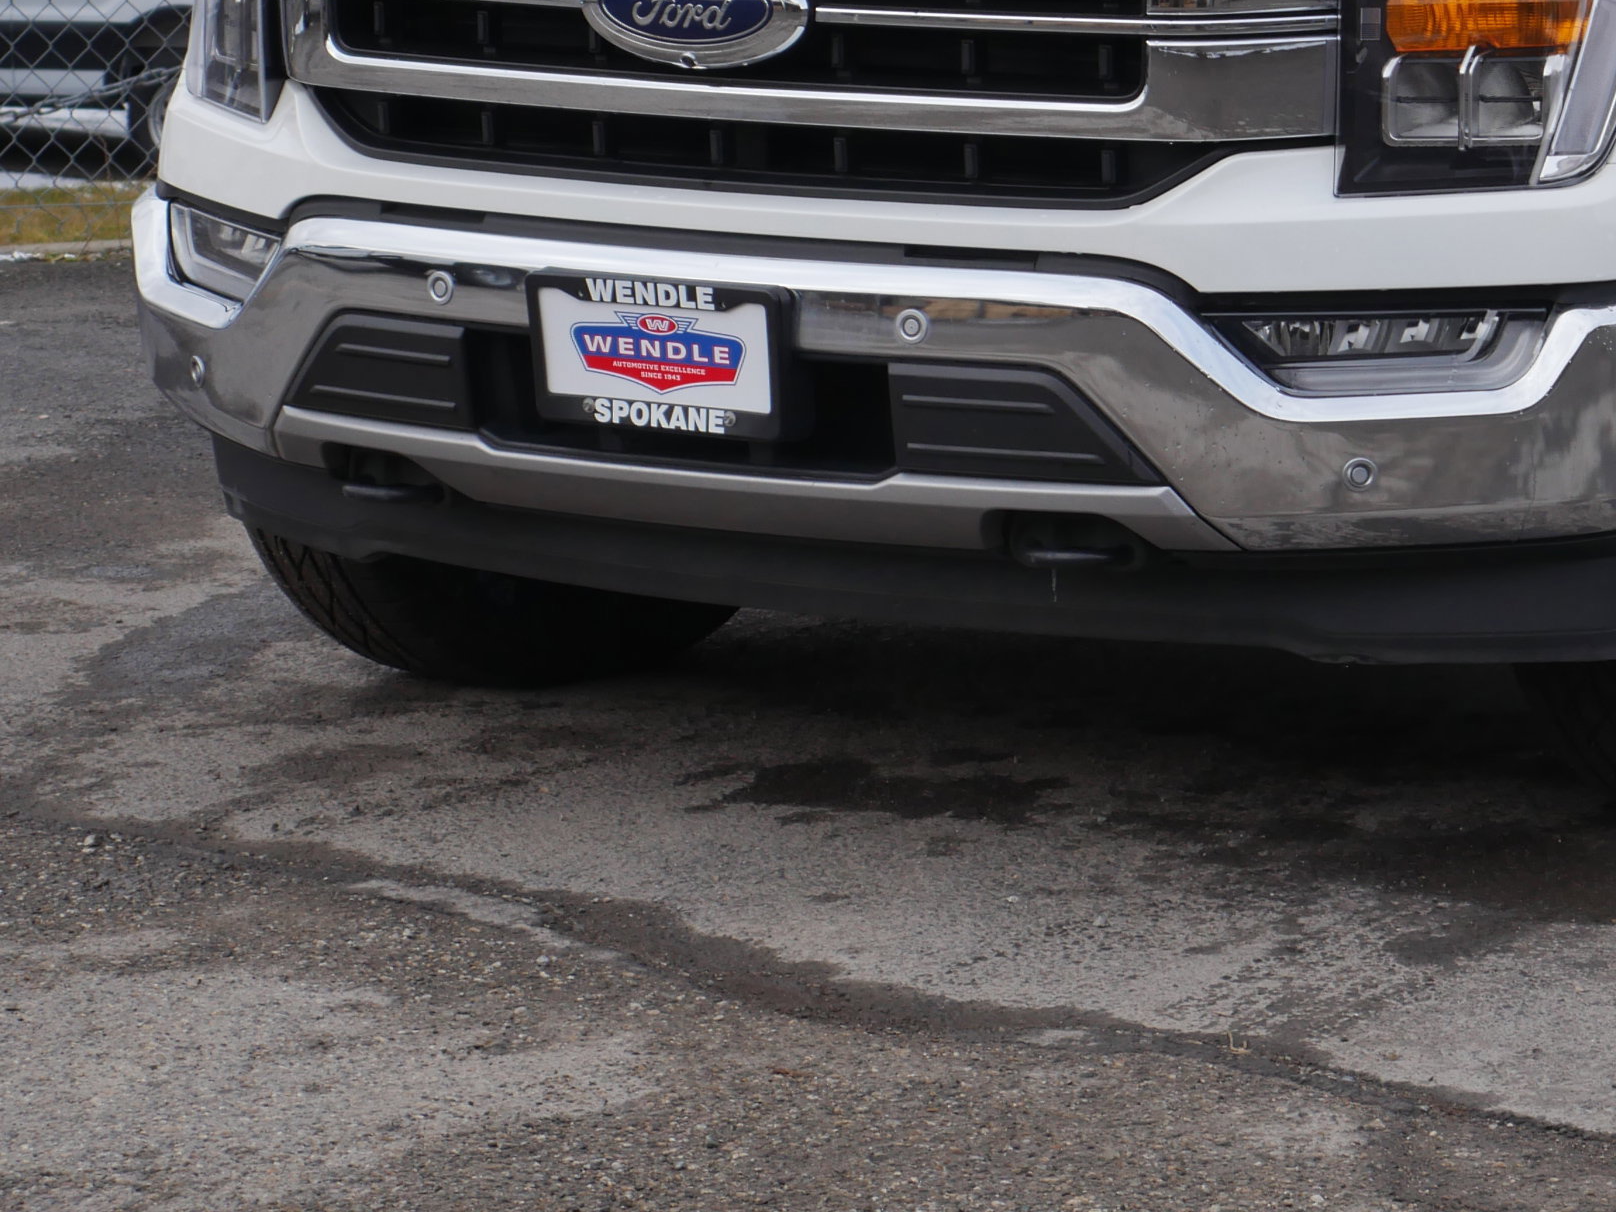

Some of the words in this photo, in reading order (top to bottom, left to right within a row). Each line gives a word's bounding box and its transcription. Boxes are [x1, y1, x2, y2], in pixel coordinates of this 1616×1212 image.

[585, 277, 716, 311] WENDLE
[583, 334, 731, 365] WENDLE
[612, 360, 659, 371] AUTOMOTIVE
[660, 365, 706, 376] EXCELLENCE
[640, 371, 662, 380] SINCE
[664, 373, 681, 381] 1943
[594, 397, 726, 435] SPOKANE
